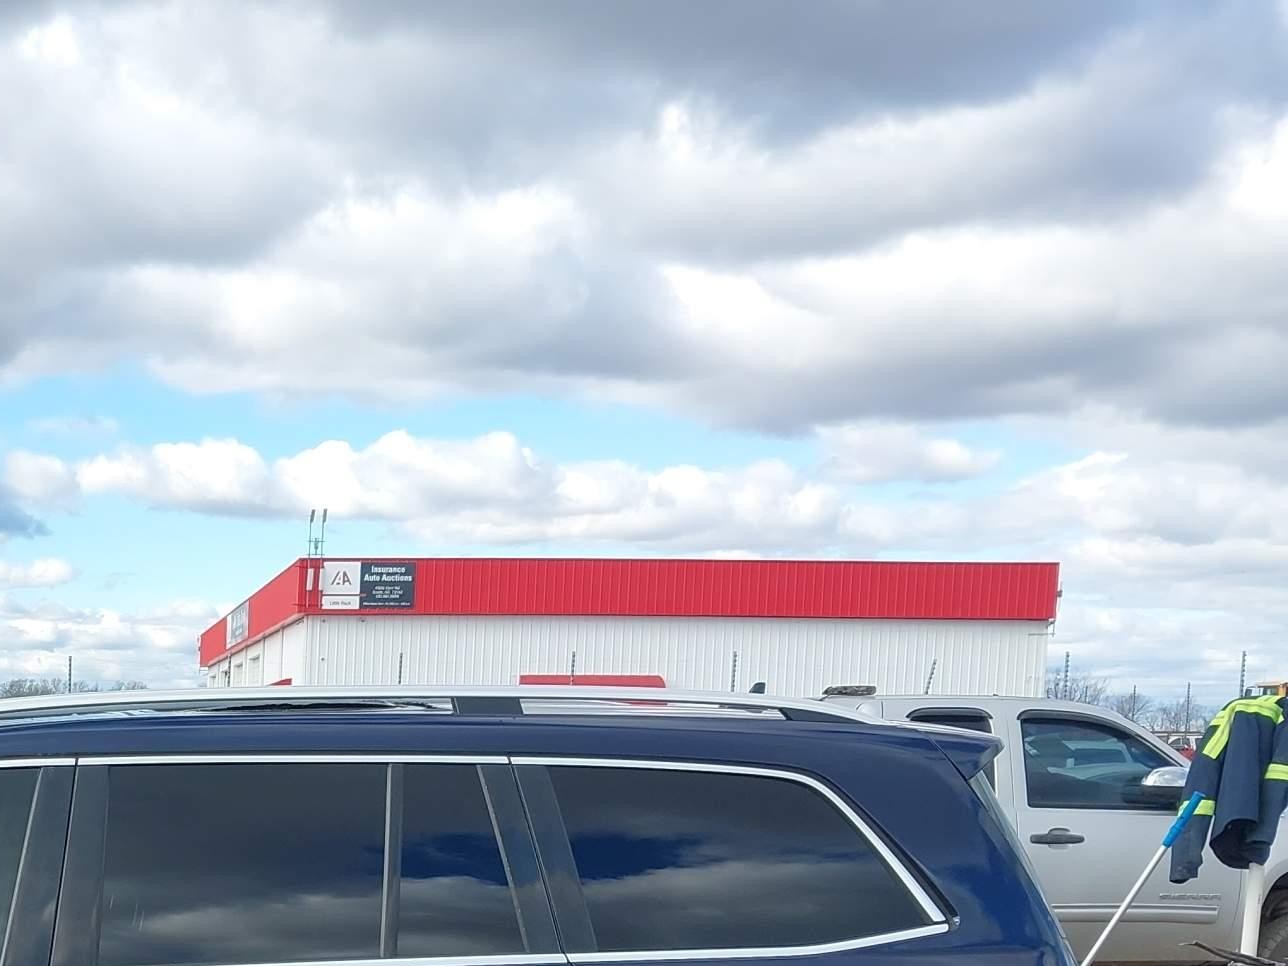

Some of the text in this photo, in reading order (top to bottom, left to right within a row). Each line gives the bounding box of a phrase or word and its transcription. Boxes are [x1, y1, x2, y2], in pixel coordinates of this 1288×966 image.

[371, 565, 406, 573] Insurance
[364, 574, 412, 582] Auto Auctions
